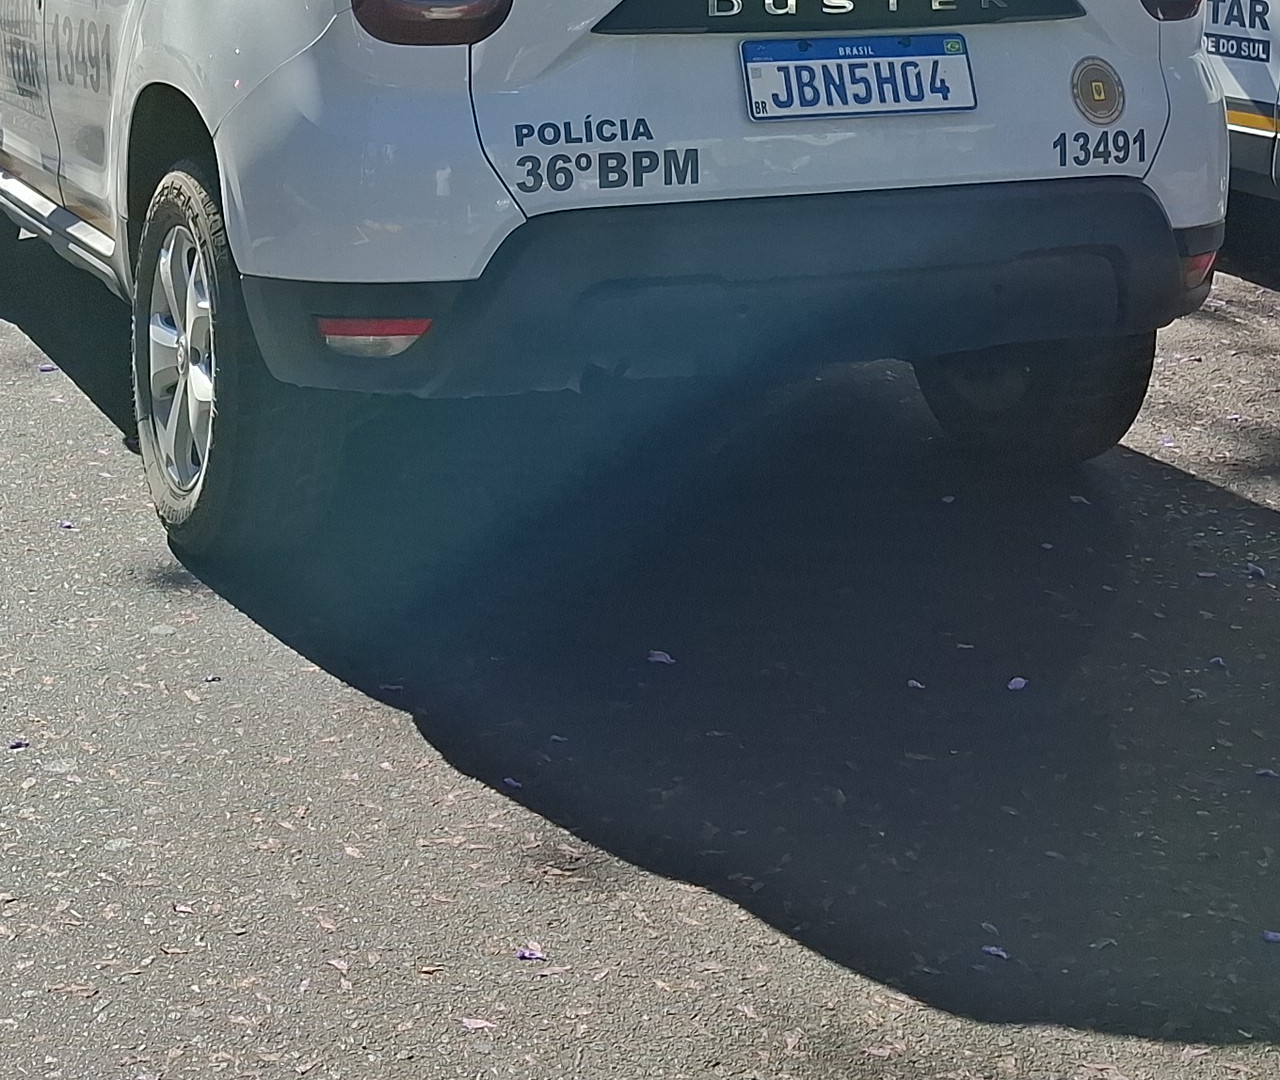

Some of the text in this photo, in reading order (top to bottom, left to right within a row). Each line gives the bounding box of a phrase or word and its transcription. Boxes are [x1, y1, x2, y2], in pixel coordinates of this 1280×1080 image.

[52, 13, 112, 97] 13491
[838, 46, 875, 57] BRASIL
[1219, 39, 1237, 55] DO
[1241, 41, 1267, 59] SUL
[771, 60, 951, 109] JBN5H04
[754, 100, 769, 115] BR
[515, 115, 654, 147] POLÍCIA
[1052, 128, 1145, 167] 13491
